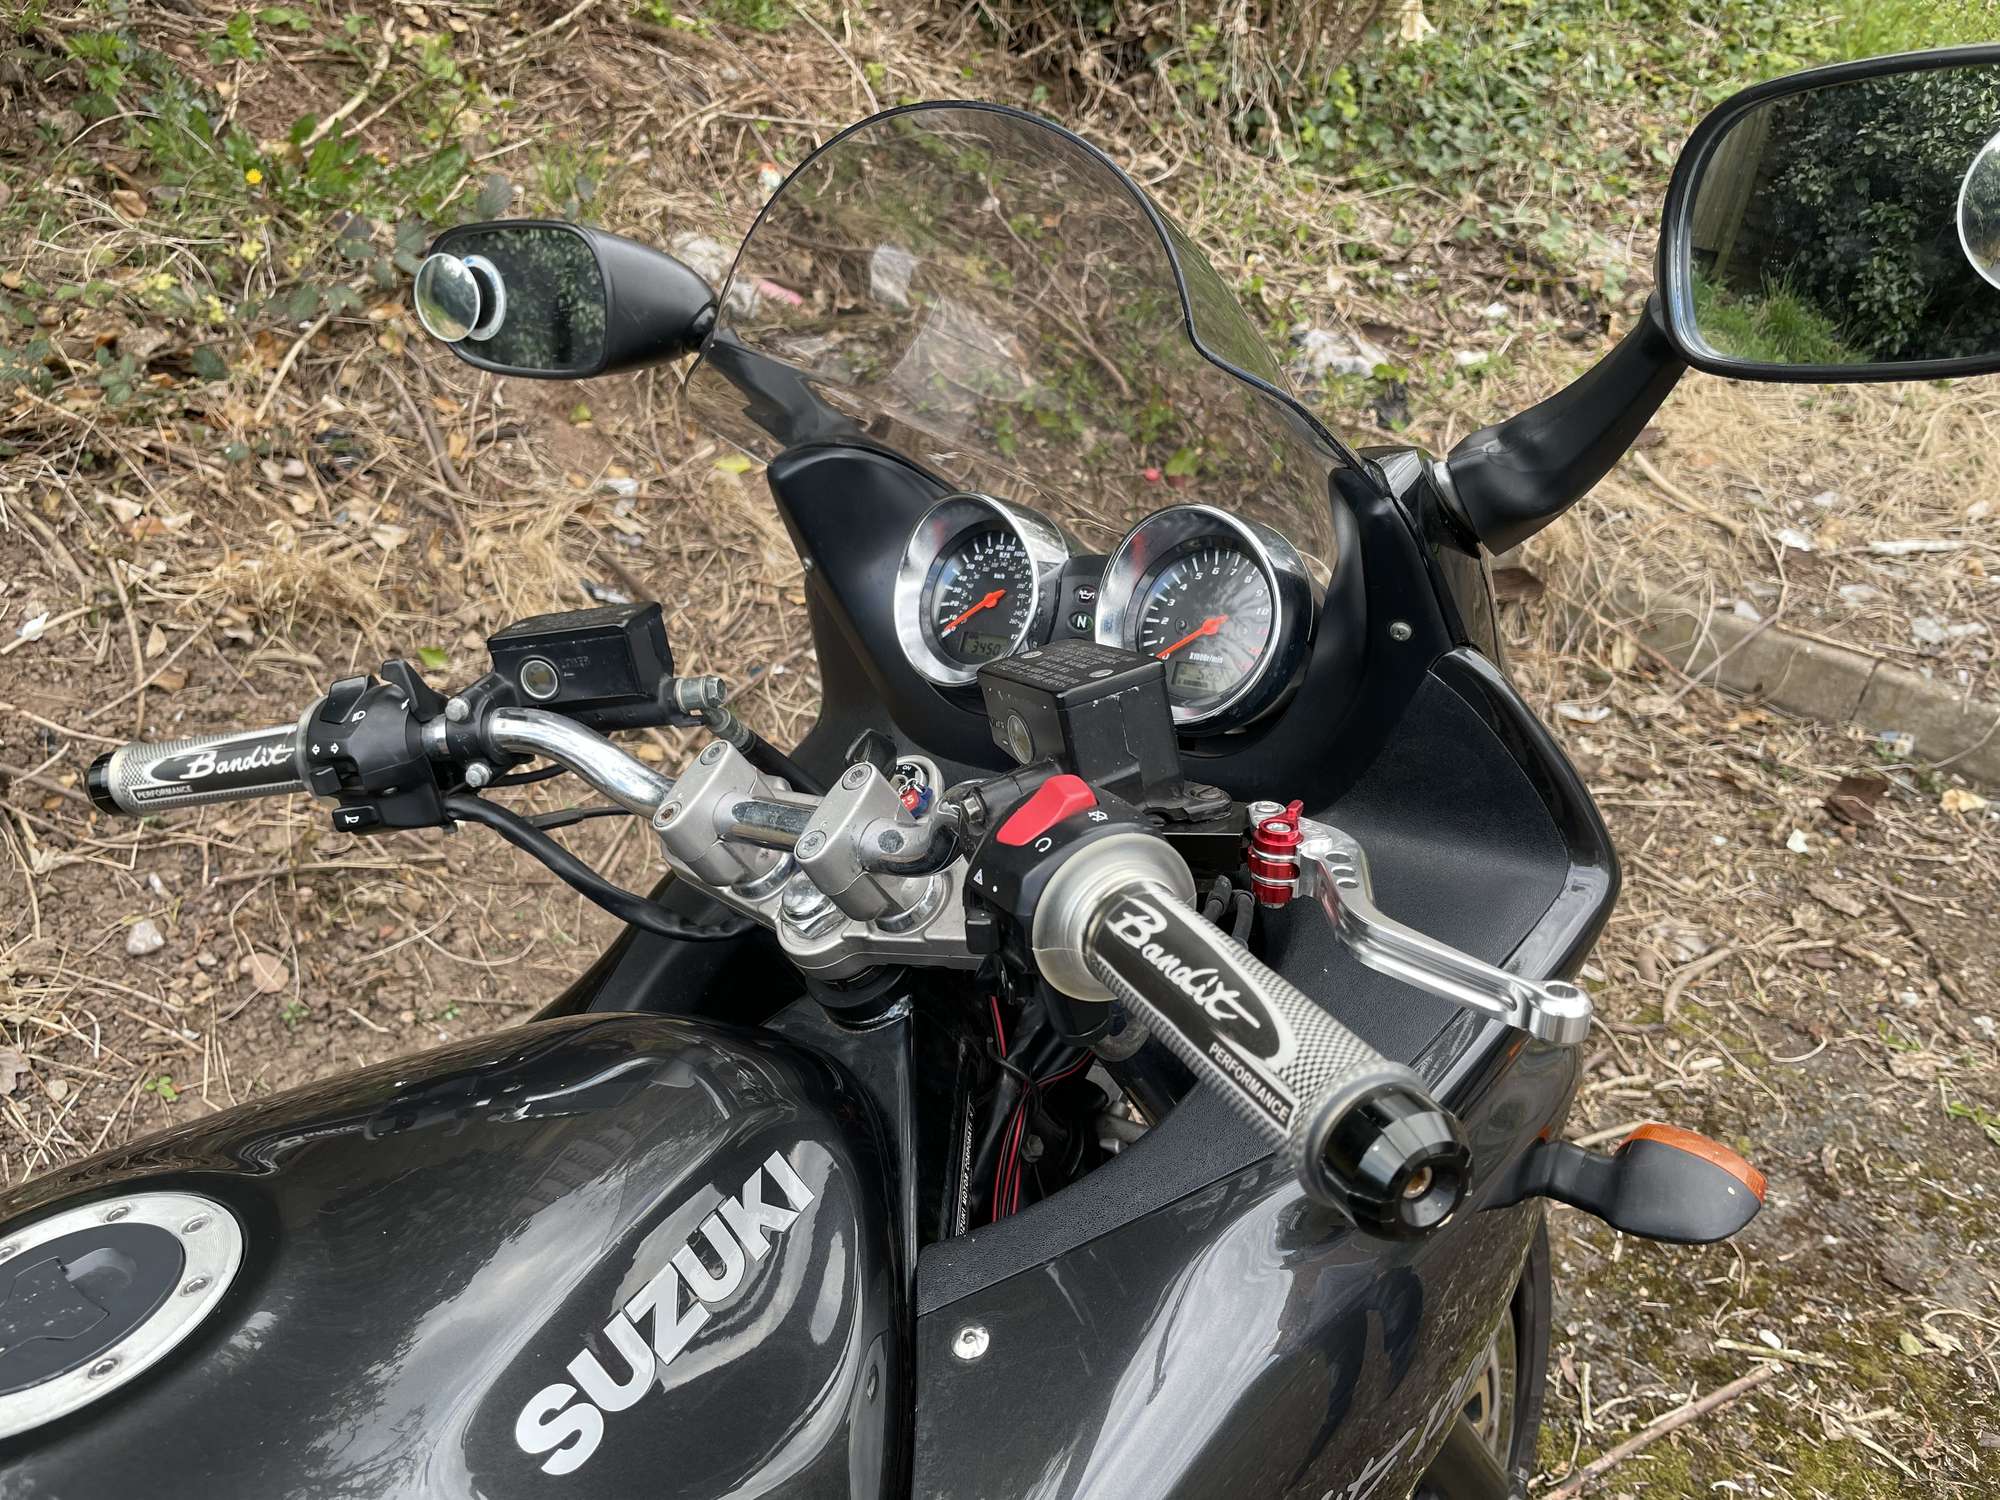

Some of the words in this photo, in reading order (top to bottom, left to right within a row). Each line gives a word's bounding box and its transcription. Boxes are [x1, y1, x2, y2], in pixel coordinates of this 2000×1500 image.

[1212, 567, 1220, 575] 6
[1230, 568, 1238, 576] 7
[1195, 572, 1204, 580] 5
[1244, 575, 1253, 584] 8
[1179, 583, 1188, 591] 4
[1256, 589, 1264, 597] 9
[1256, 607, 1269, 615] 10
[1076, 615, 1087, 628] N
[1161, 617, 1169, 625] 2
[179, 744, 296, 780] Bandit
[136, 784, 194, 800] PERFORMANCE
[1108, 898, 1262, 1030] Bandit
[1207, 1041, 1292, 1123] PERFORMANCE
[962, 1172, 970, 1206] MOTOR
[515, 1150, 816, 1476] SUZUKI
